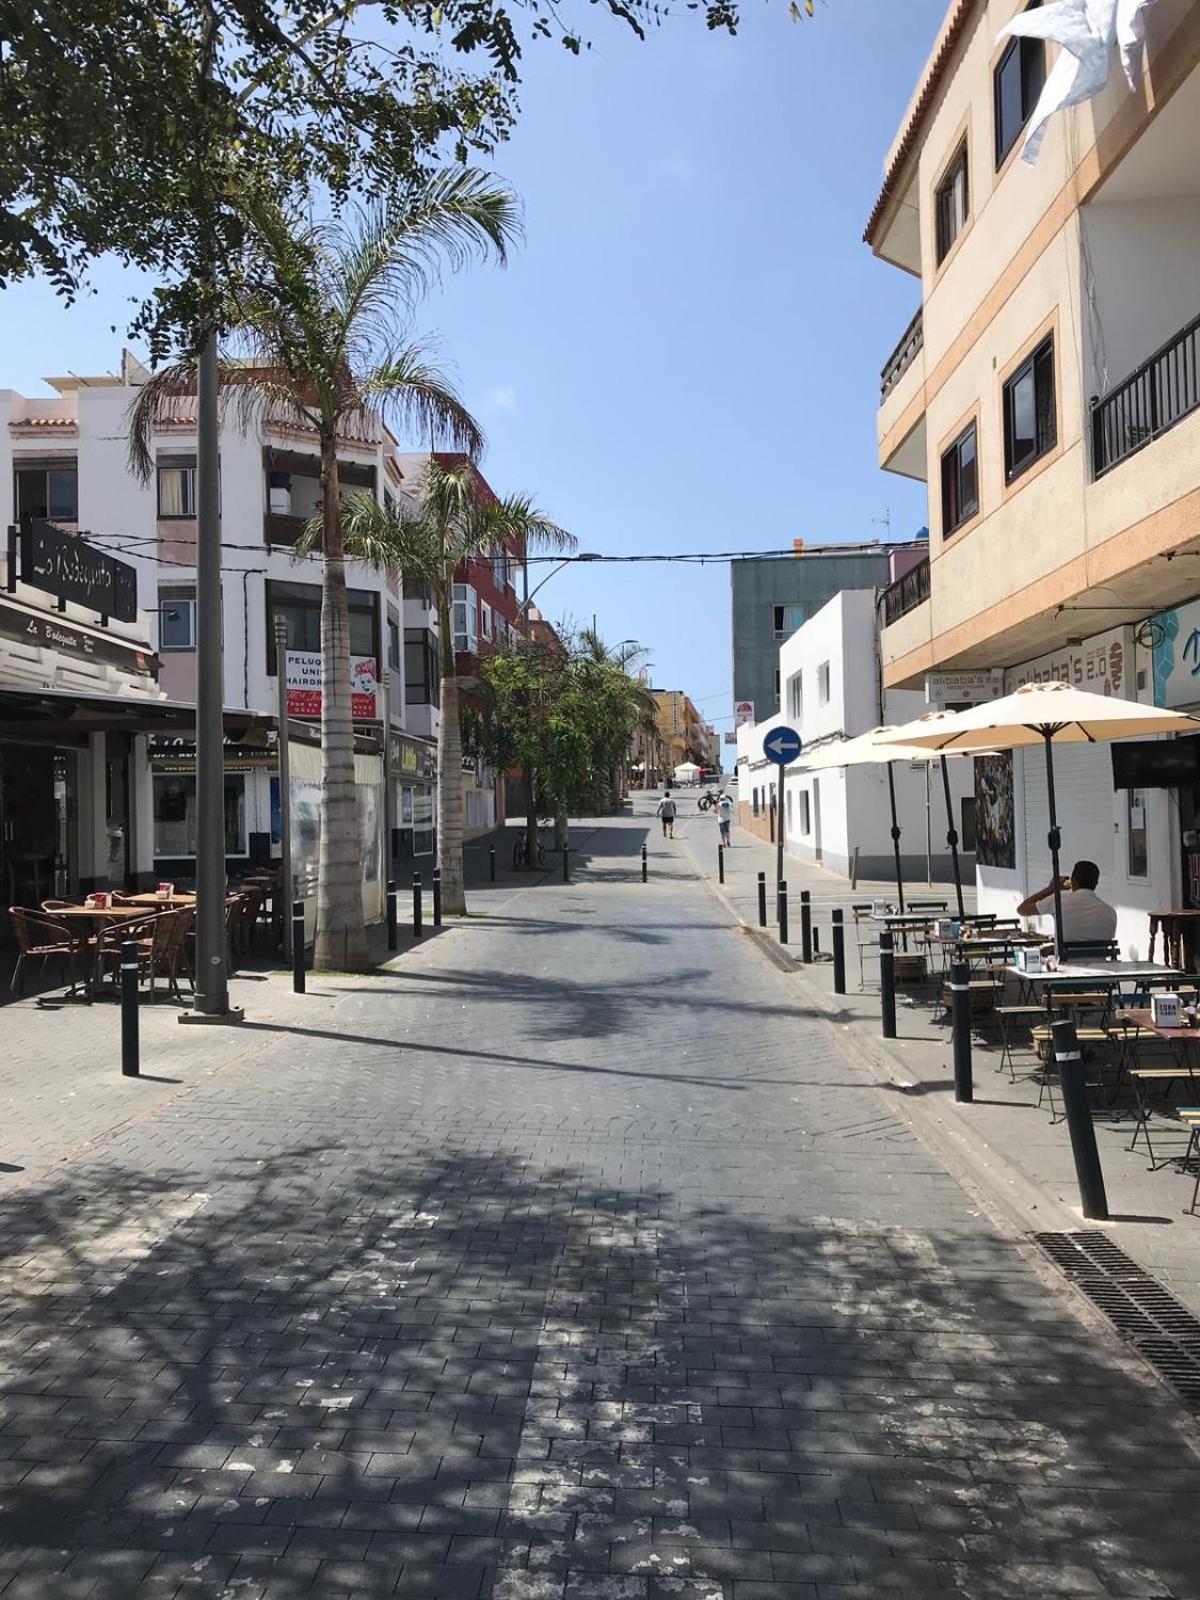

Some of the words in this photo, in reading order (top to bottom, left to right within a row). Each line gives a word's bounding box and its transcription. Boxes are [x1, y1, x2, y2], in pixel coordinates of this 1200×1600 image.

[26, 620, 38, 634] La
[45, 625, 77, 647] Bodeguita
[288, 656, 322, 666] PELUQ
[1086, 656, 1107, 680] 2.0
